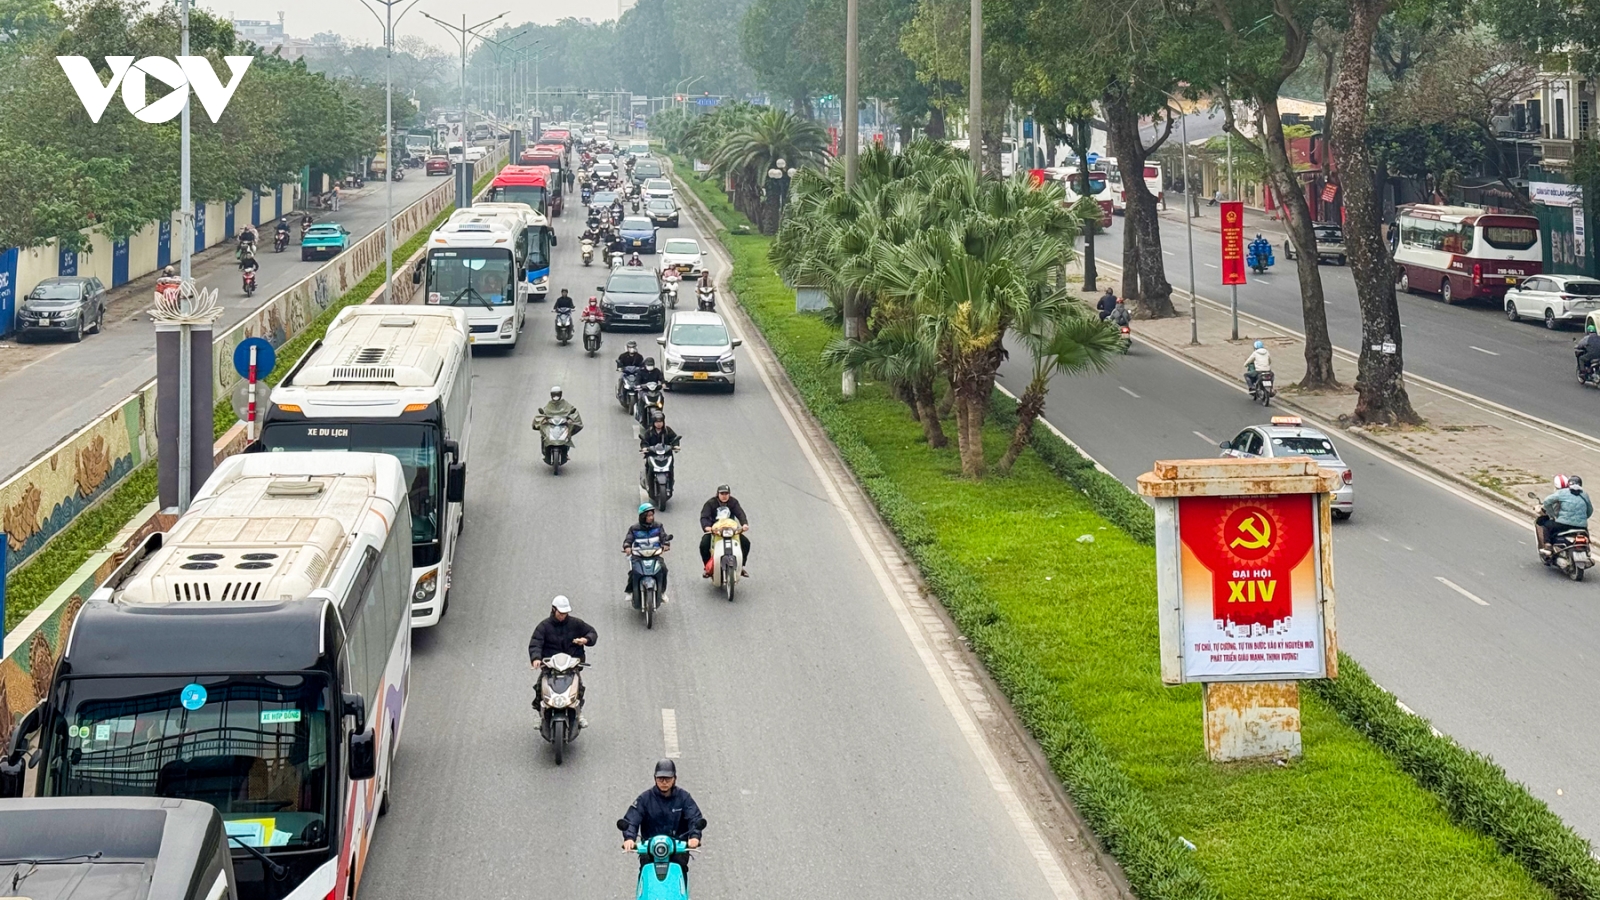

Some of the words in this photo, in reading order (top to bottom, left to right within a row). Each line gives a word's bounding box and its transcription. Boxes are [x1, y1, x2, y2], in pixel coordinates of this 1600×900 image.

[307, 428, 317, 436] XE
[319, 428, 330, 436] DU
[331, 429, 348, 437] LỊCH
[1232, 569, 1250, 579] ĐẠI
[1253, 568, 1271, 579] HỘI
[1227, 580, 1277, 603] XIV
[1245, 642, 1253, 650] TIN
[1267, 640, 1277, 650] VÀO
[1284, 640, 1304, 650] NGUYÊN
[1210, 653, 1222, 663] PHÁT
[1266, 653, 1281, 663] THỊNH
[271, 712, 283, 721] HỢP
[284, 710, 299, 719] ĐỒNG
